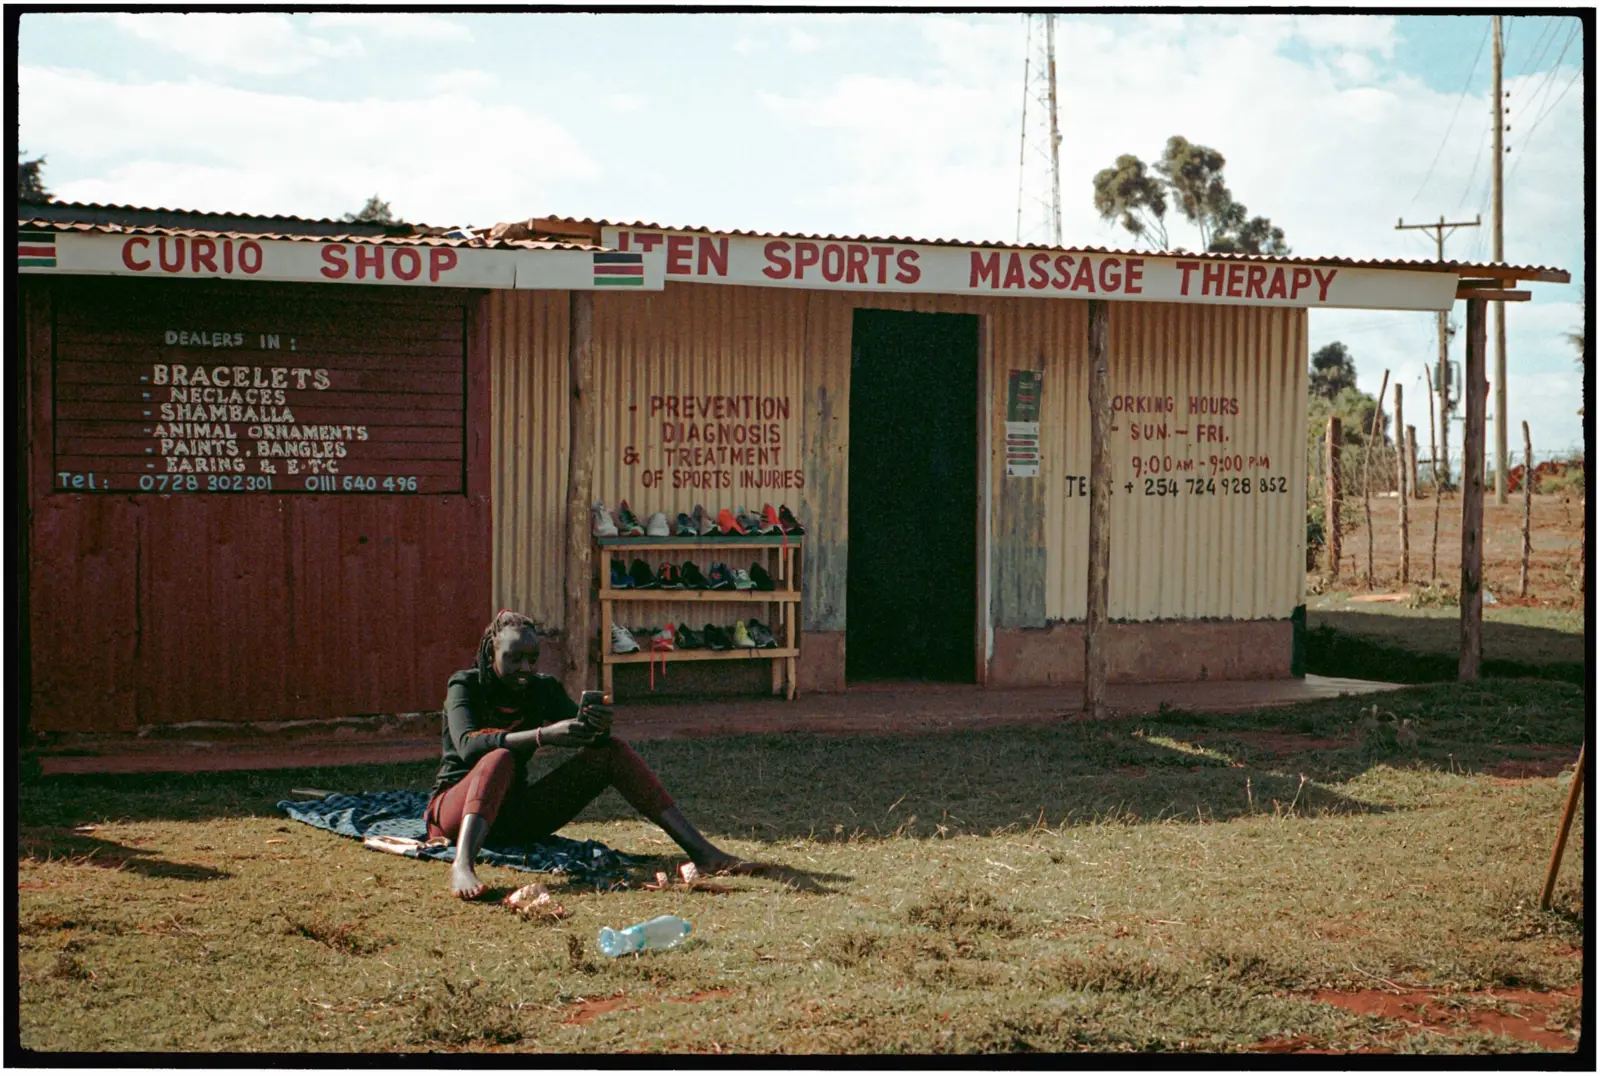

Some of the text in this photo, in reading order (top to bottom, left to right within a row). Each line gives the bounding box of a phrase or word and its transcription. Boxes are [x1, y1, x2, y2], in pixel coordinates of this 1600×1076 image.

[122, 236, 458, 282] CURIO SHOP
[761, 240, 922, 285] SPORTS
[968, 250, 1145, 294] MASSAGE
[1175, 260, 1338, 302] THERAPY
[164, 330, 244, 347] DEALERS
[169, 386, 286, 405] NECLACES
[1112, 395, 1240, 416] ORKING HOURS
[160, 402, 296, 423] SHAMBALLA
[650, 395, 790, 420] PREVENTION
[662, 422, 781, 445] DIAGNOSIS
[257, 440, 347, 459] BANGLES
[623, 445, 781, 468] & TREATMENT
[165, 456, 246, 473] EARING
[260, 458, 276, 475] &
[1132, 455, 1172, 478] 9:00
[1210, 454, 1243, 476] 9:00
[139, 474, 199, 491] 0728
[343, 475, 377, 491] 640
[382, 475, 418, 492] 496
[641, 469, 805, 490] OF SPORTS INJURIES
[1144, 478, 1179, 497] 254
[1185, 478, 1216, 496] 724
[1221, 477, 1252, 496] 928
[1259, 476, 1288, 494] 852
